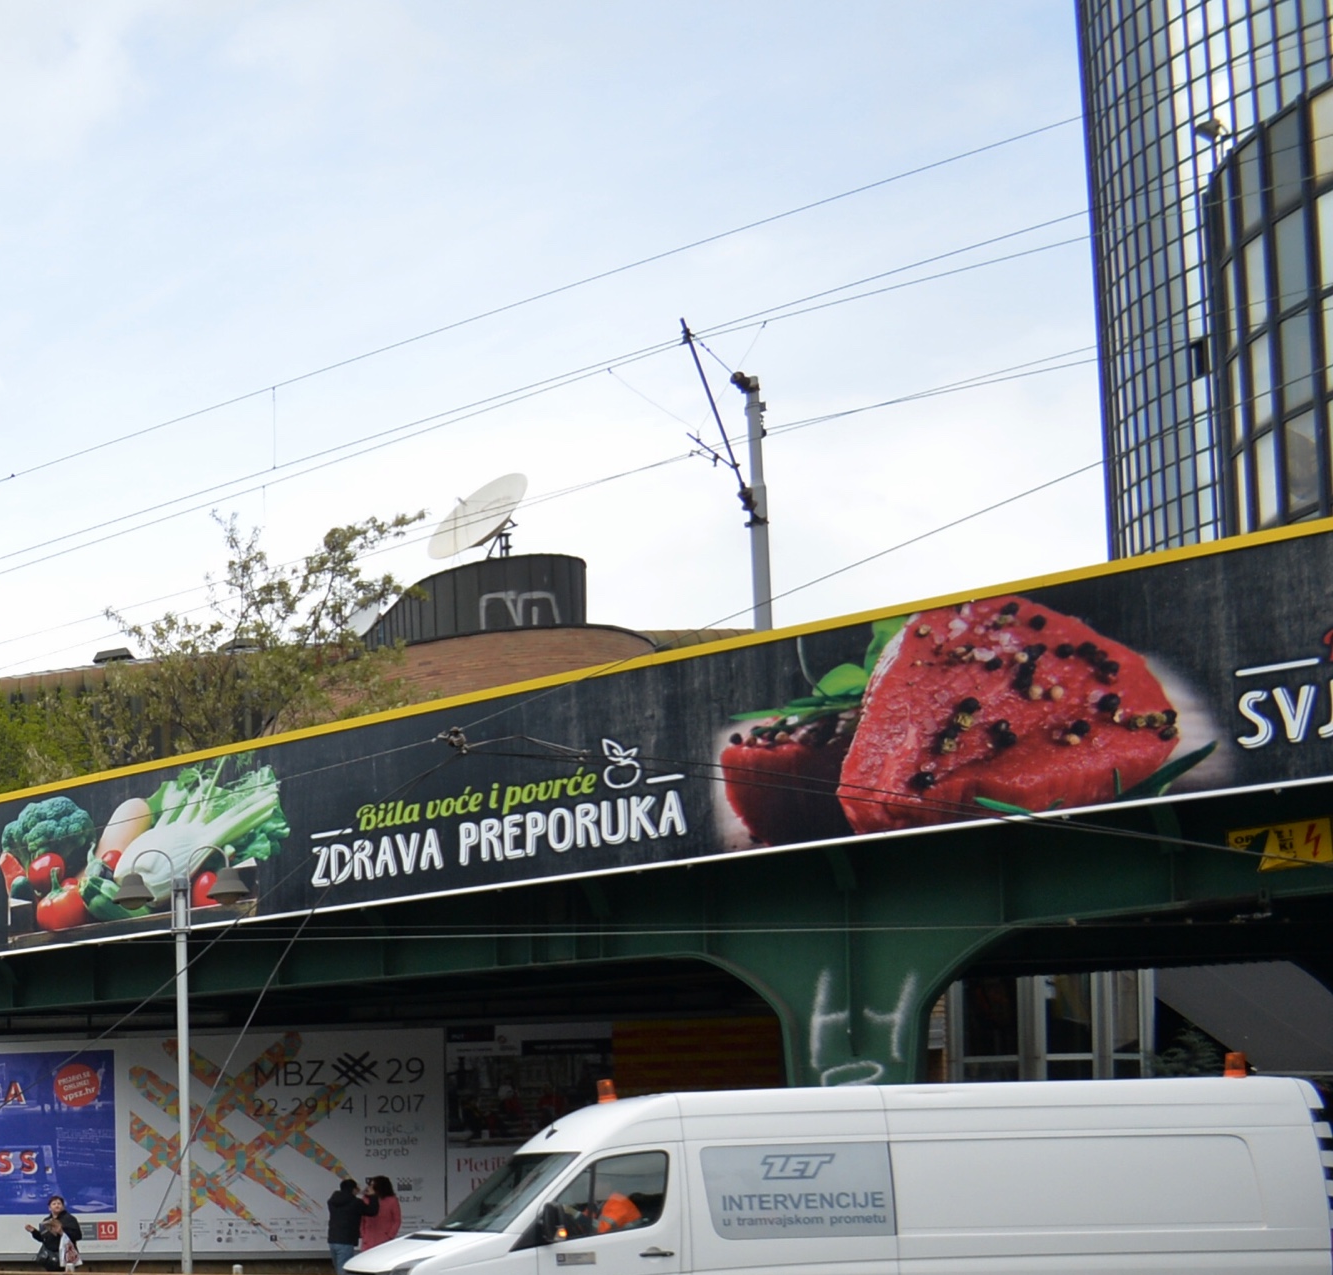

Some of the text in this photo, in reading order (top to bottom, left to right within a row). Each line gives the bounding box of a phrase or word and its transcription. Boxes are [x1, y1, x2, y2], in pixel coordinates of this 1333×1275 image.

[356, 767, 597, 831] Billa voće i povrće
[311, 789, 687, 888] ZDRAVA PREPORUKA
[253, 1057, 425, 1088] MBZ 29
[62, 1087, 96, 1101] vpsz.hr
[252, 1096, 319, 1117] 22-29
[340, 1097, 354, 1114] 4
[378, 1094, 425, 1114] 2017
[364, 1135, 418, 1146] biennale
[364, 1147, 409, 1159] zagreb
[760, 1153, 836, 1180] ZET
[722, 1191, 885, 1211] INTERVENCIJE
[100, 1224, 115, 1235] 10
[723, 1213, 887, 1228] u tramvajskom prometu
